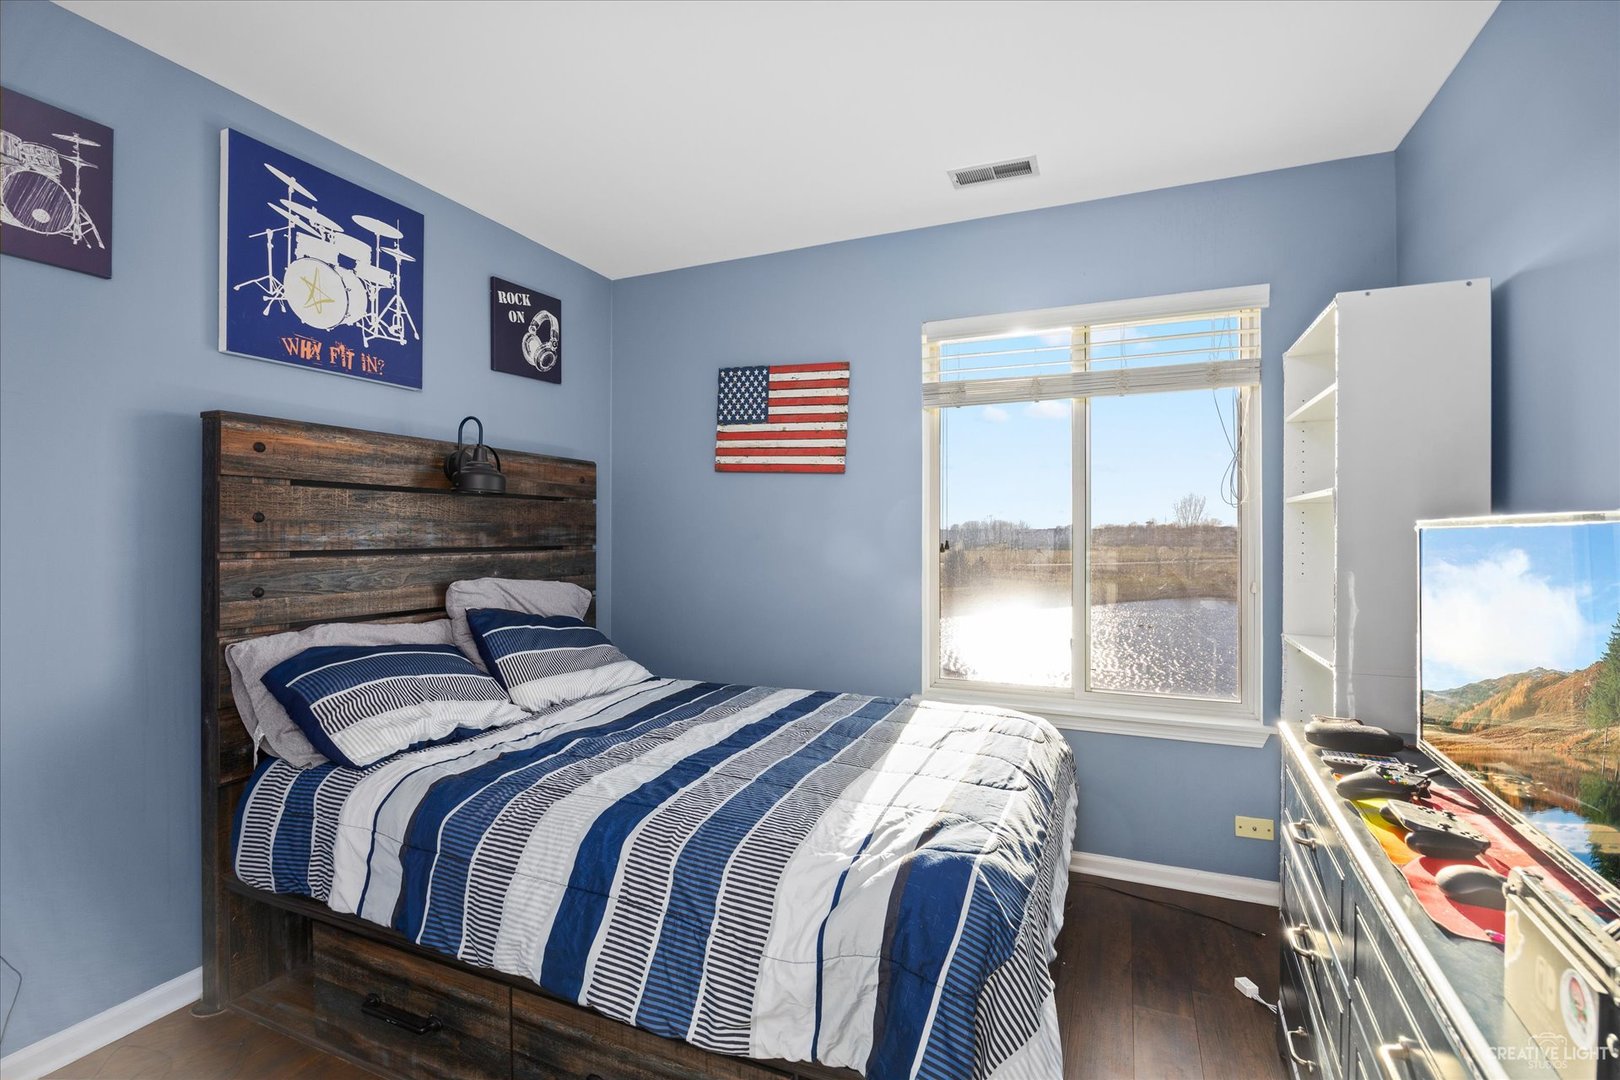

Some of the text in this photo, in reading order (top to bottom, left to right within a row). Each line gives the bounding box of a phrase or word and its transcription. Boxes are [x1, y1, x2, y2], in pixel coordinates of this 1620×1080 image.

[497, 290, 532, 307] ROCK
[508, 310, 525, 323] ON
[281, 336, 385, 376] WHY FIT IN?
